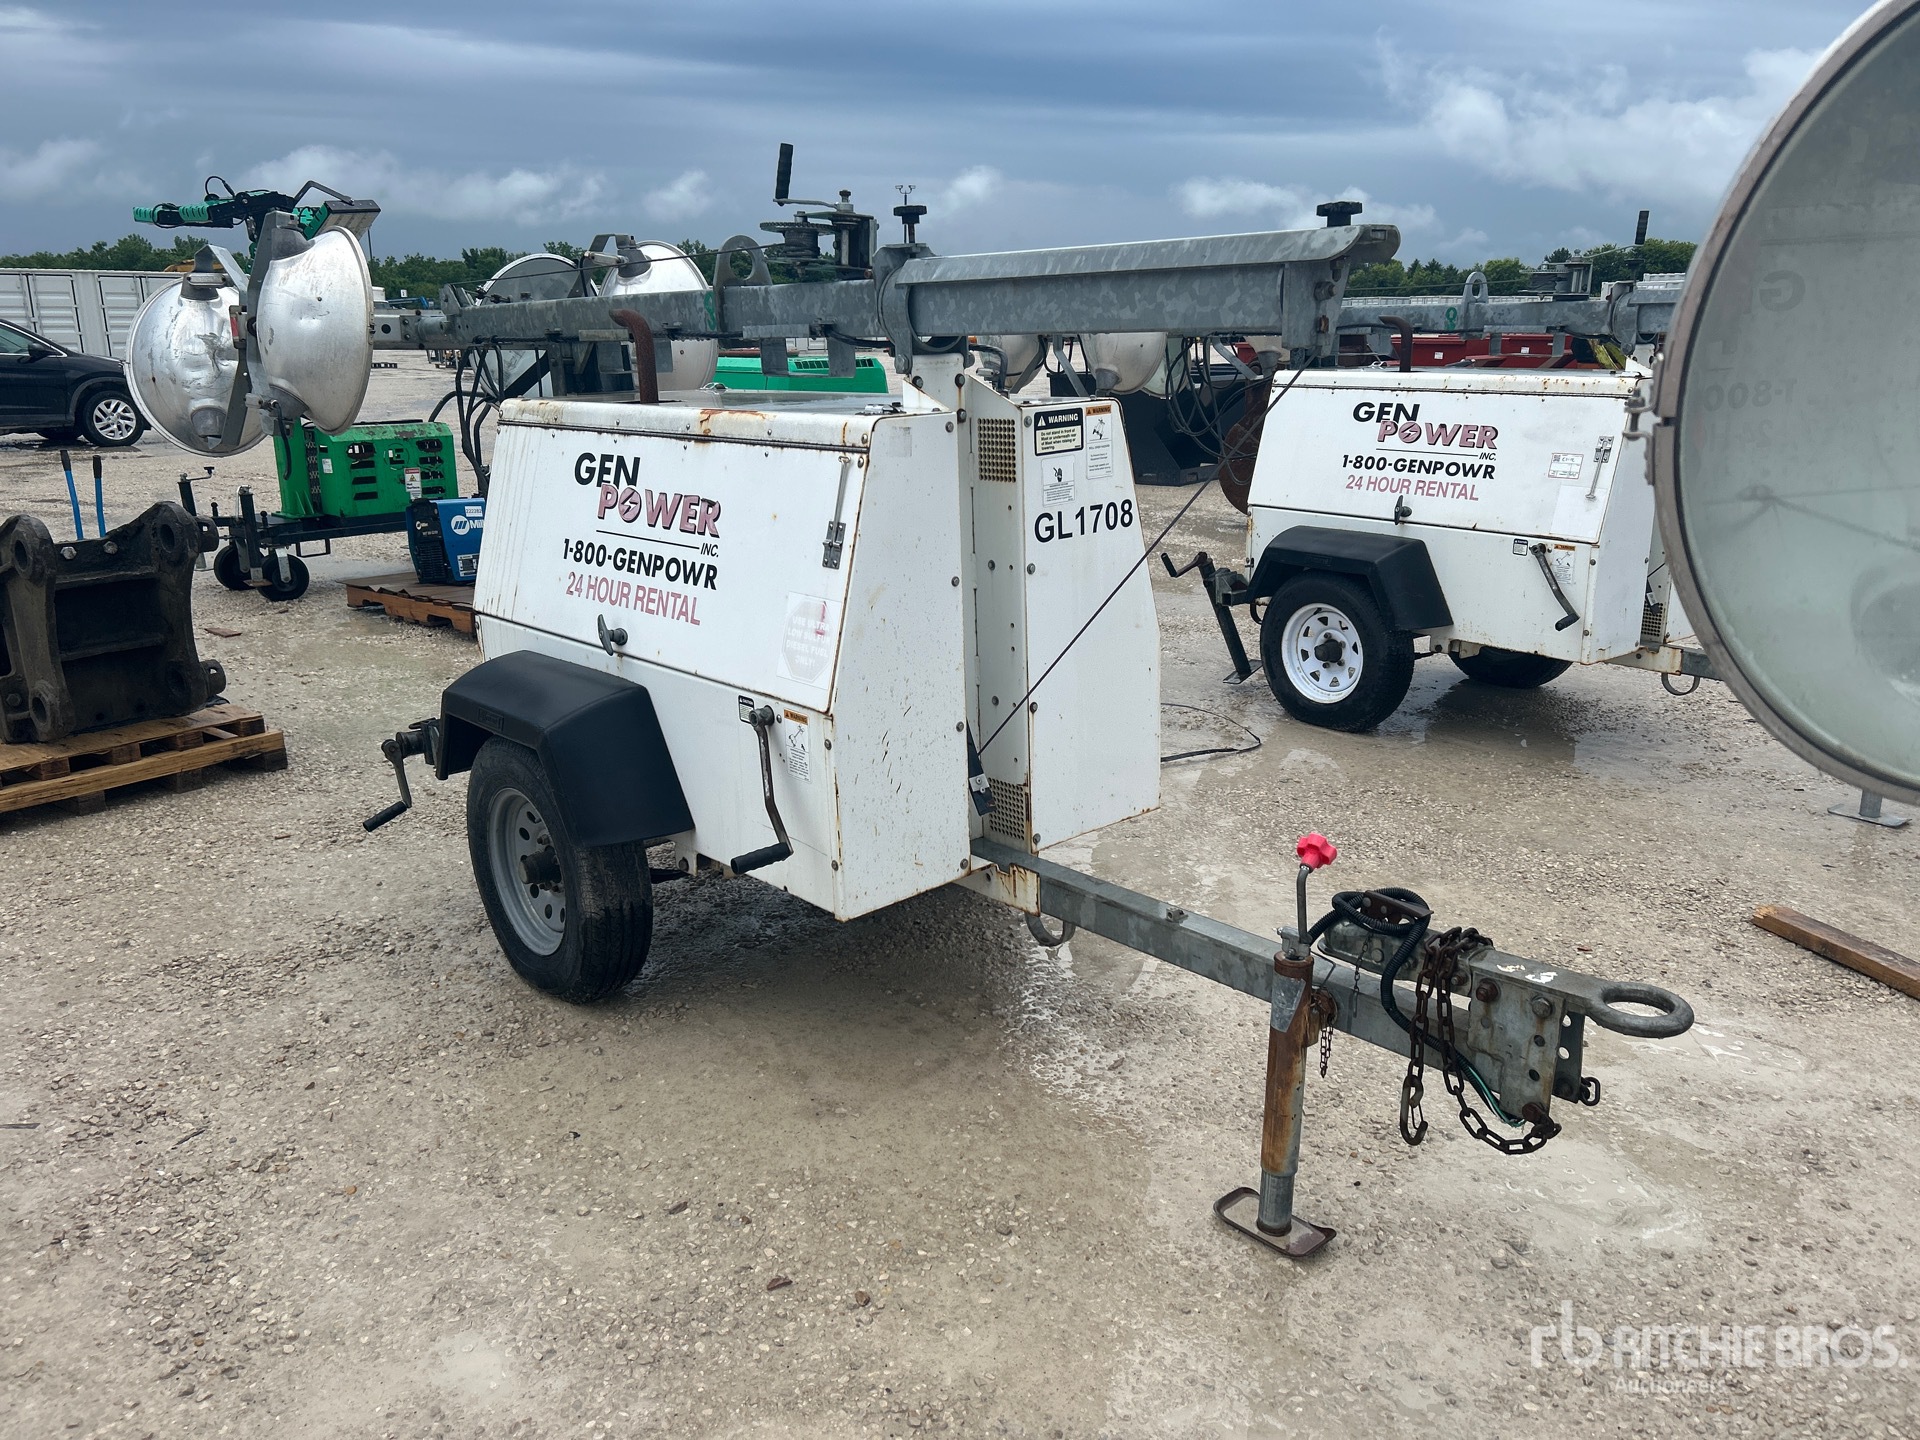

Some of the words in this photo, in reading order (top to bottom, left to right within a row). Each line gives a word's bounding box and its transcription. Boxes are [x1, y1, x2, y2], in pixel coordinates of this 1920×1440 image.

[1048, 413, 1079, 424] WARNING
[1352, 402, 1420, 424] GEN
[1377, 420, 1499, 450] POWER
[574, 452, 641, 489] GEN
[1342, 454, 1496, 480] 1-800-GENPOWR
[1479, 452, 1497, 461] INC.
[1345, 474, 1364, 491] 24
[1366, 475, 1412, 495] HOUR
[1414, 479, 1479, 502] RENTAL
[597, 483, 721, 538] POWER
[1034, 498, 1133, 543] GL1708
[563, 538, 718, 591] 1-800-GENPOWR
[700, 542, 719, 558] INC.
[566, 571, 584, 598] 24
[585, 574, 632, 609] HOUR
[633, 584, 701, 626] RENTAL
